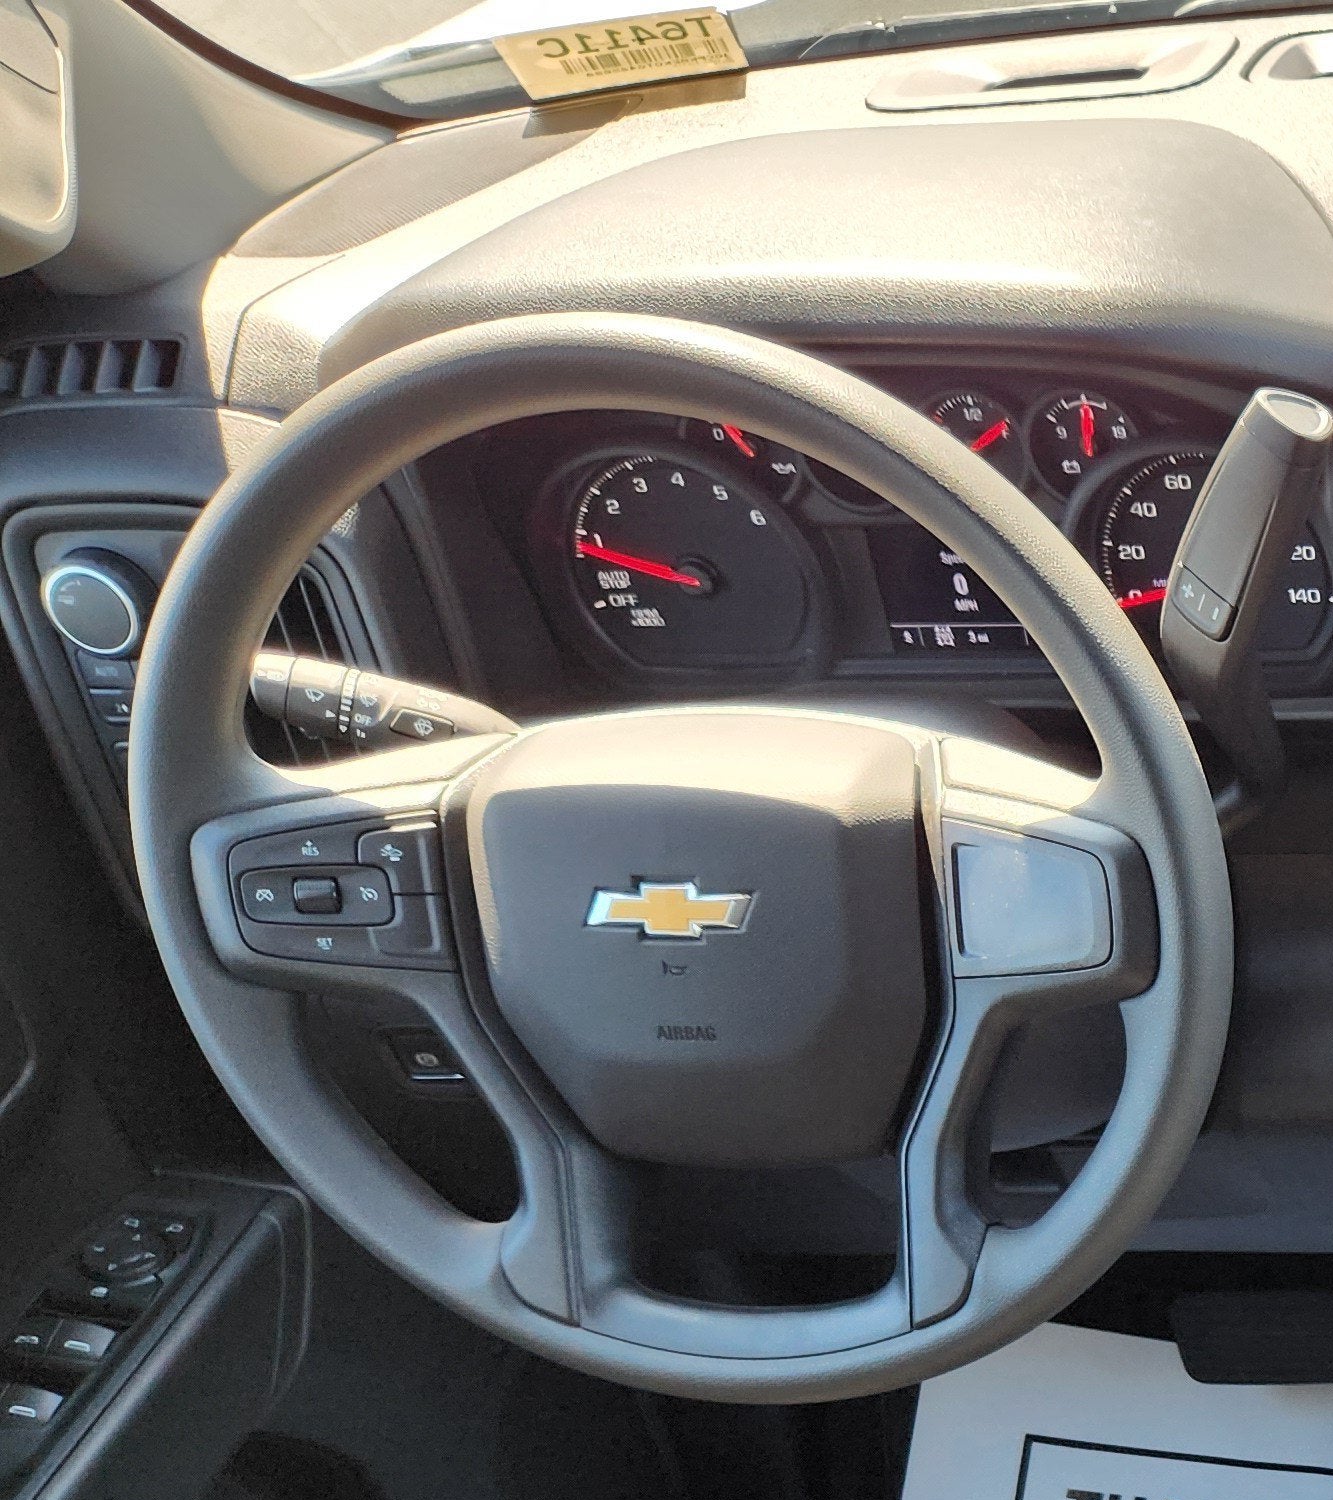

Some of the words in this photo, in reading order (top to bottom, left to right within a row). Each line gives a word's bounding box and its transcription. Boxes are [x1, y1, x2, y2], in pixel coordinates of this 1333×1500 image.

[712, 427, 725, 441] 0
[1055, 425, 1068, 440] 9
[632, 477, 648, 493] 3
[671, 472, 685, 487] 4
[1164, 474, 1192, 490] 60
[713, 485, 729, 501] 5
[606, 499, 621, 515] 2
[1130, 501, 1158, 518] 40
[750, 509, 766, 526] 6
[1118, 545, 1146, 560] 20
[953, 573, 969, 595] 0
[608, 594, 639, 607] OFF
[1288, 588, 1321, 604] 140
[354, 713, 373, 726] OFF
[656, 1025, 717, 1041] AIRBAG
